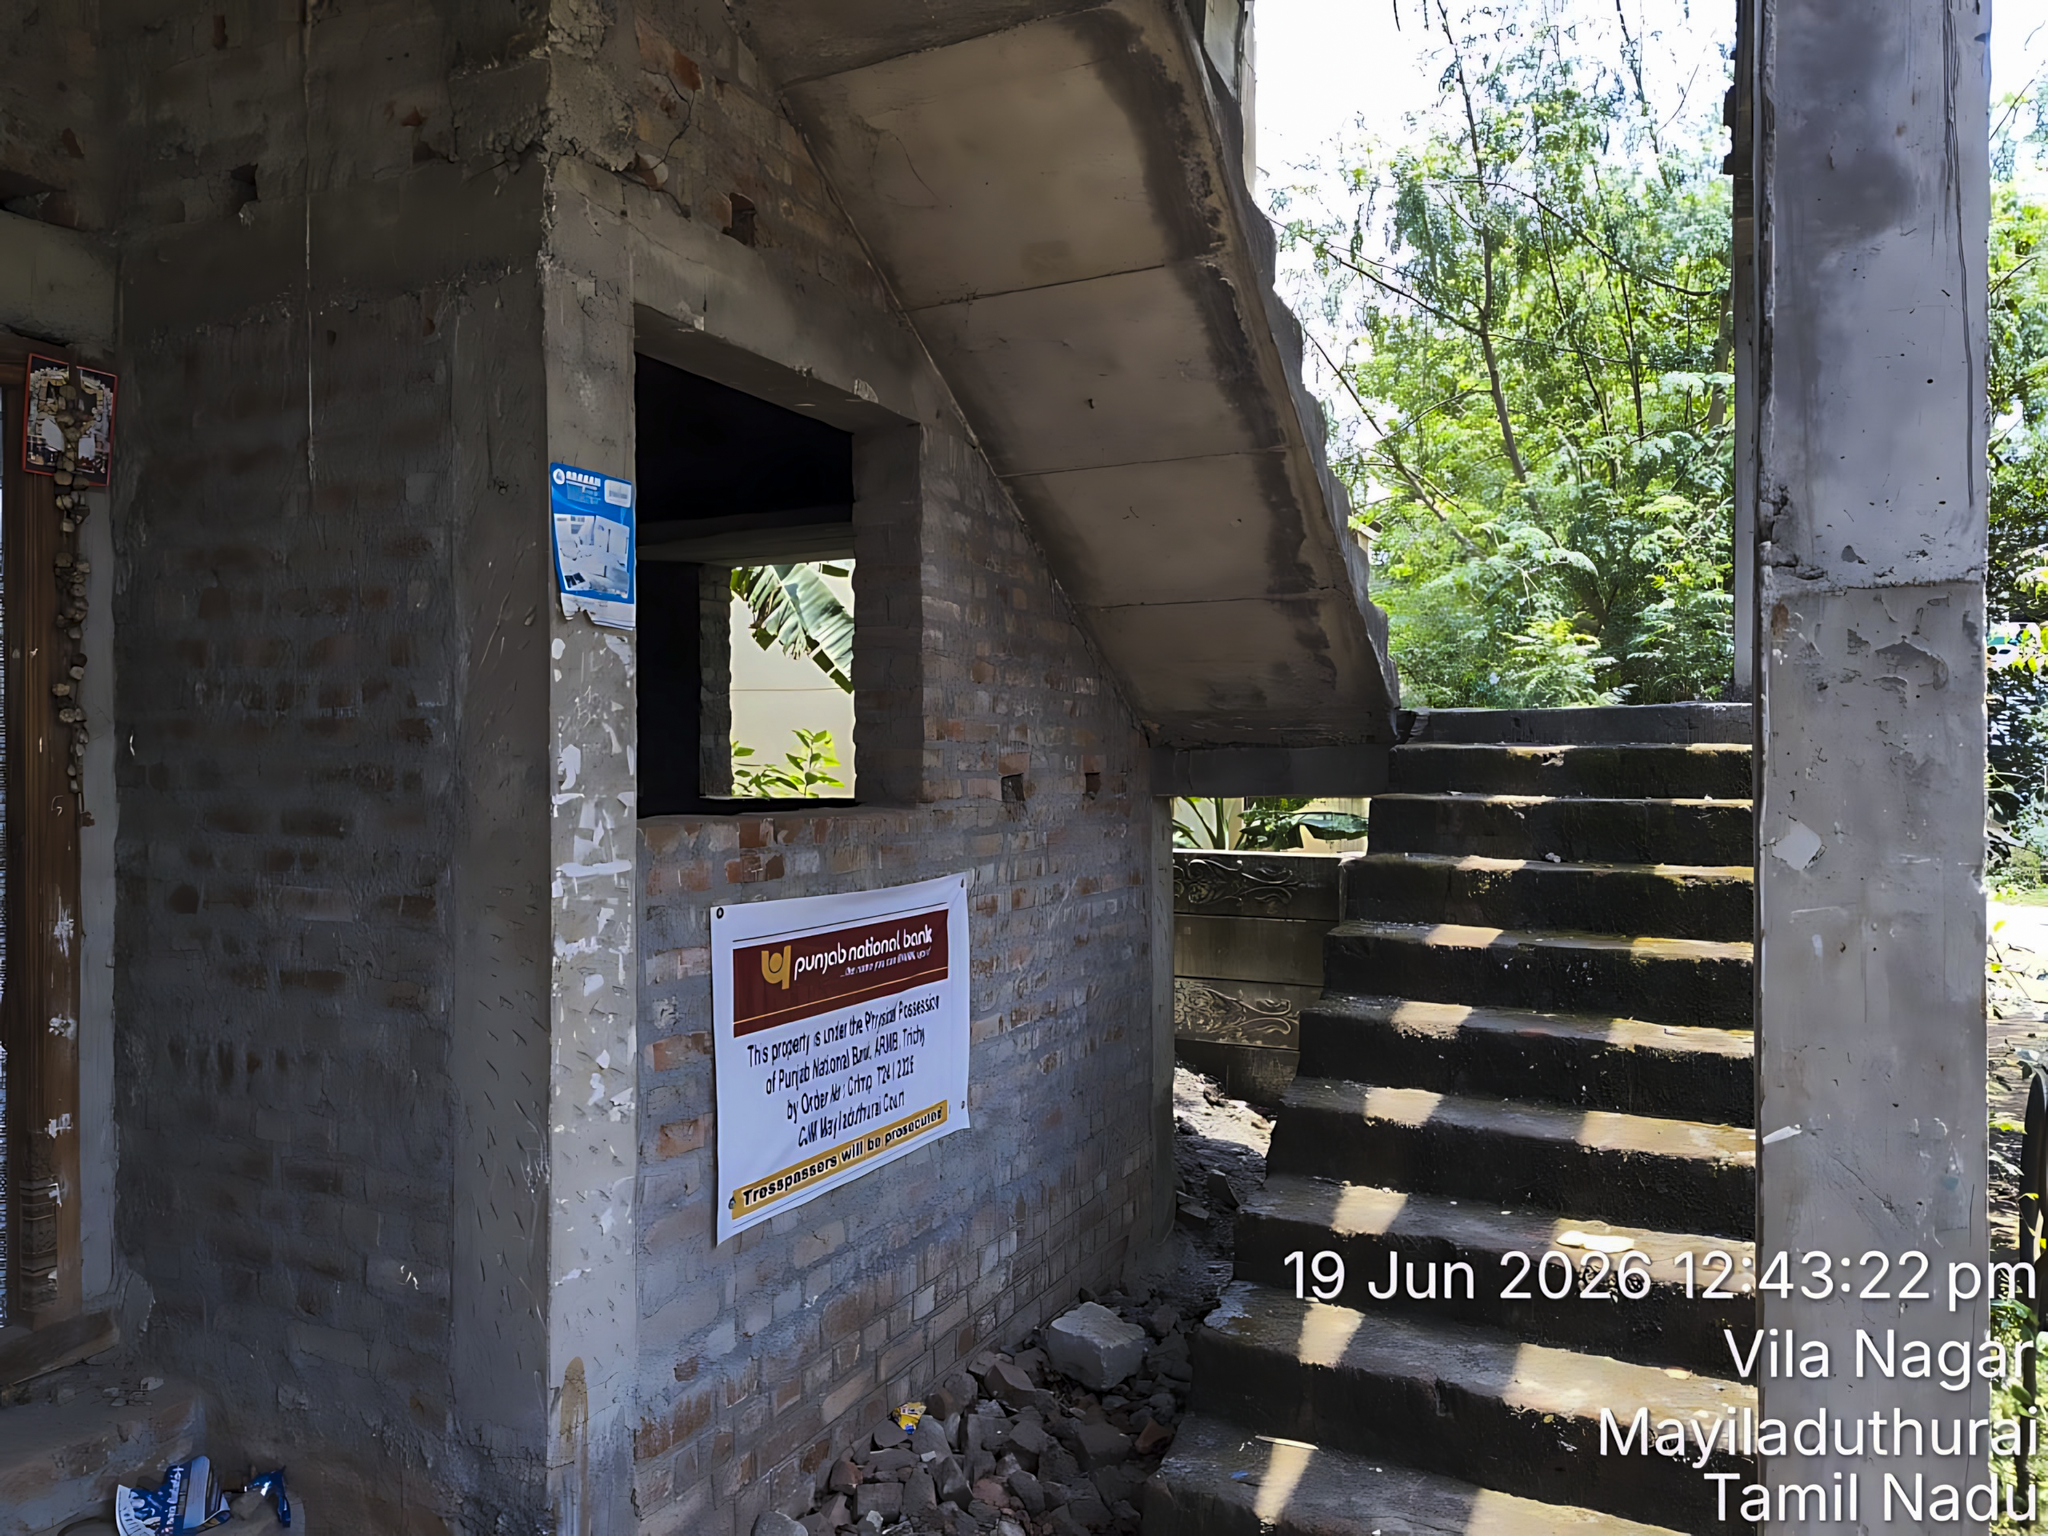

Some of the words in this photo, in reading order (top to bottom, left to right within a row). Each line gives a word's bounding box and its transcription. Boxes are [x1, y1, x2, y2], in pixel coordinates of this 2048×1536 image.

[794, 942, 847, 981] punjab
[848, 930, 900, 961] national
[903, 924, 933, 948] bank
[747, 1044, 768, 1067] This
[772, 1032, 810, 1065] property
[813, 1030, 821, 1047] is
[823, 1021, 848, 1045] under
[849, 1015, 863, 1037] the
[766, 1072, 776, 1095] of
[779, 1062, 809, 1091] Punjab
[812, 1049, 849, 1079] National
[787, 1098, 799, 1124] by
[801, 1089, 828, 1114] Order
[841, 1141, 863, 1162] will
[868, 1136, 881, 1151] be
